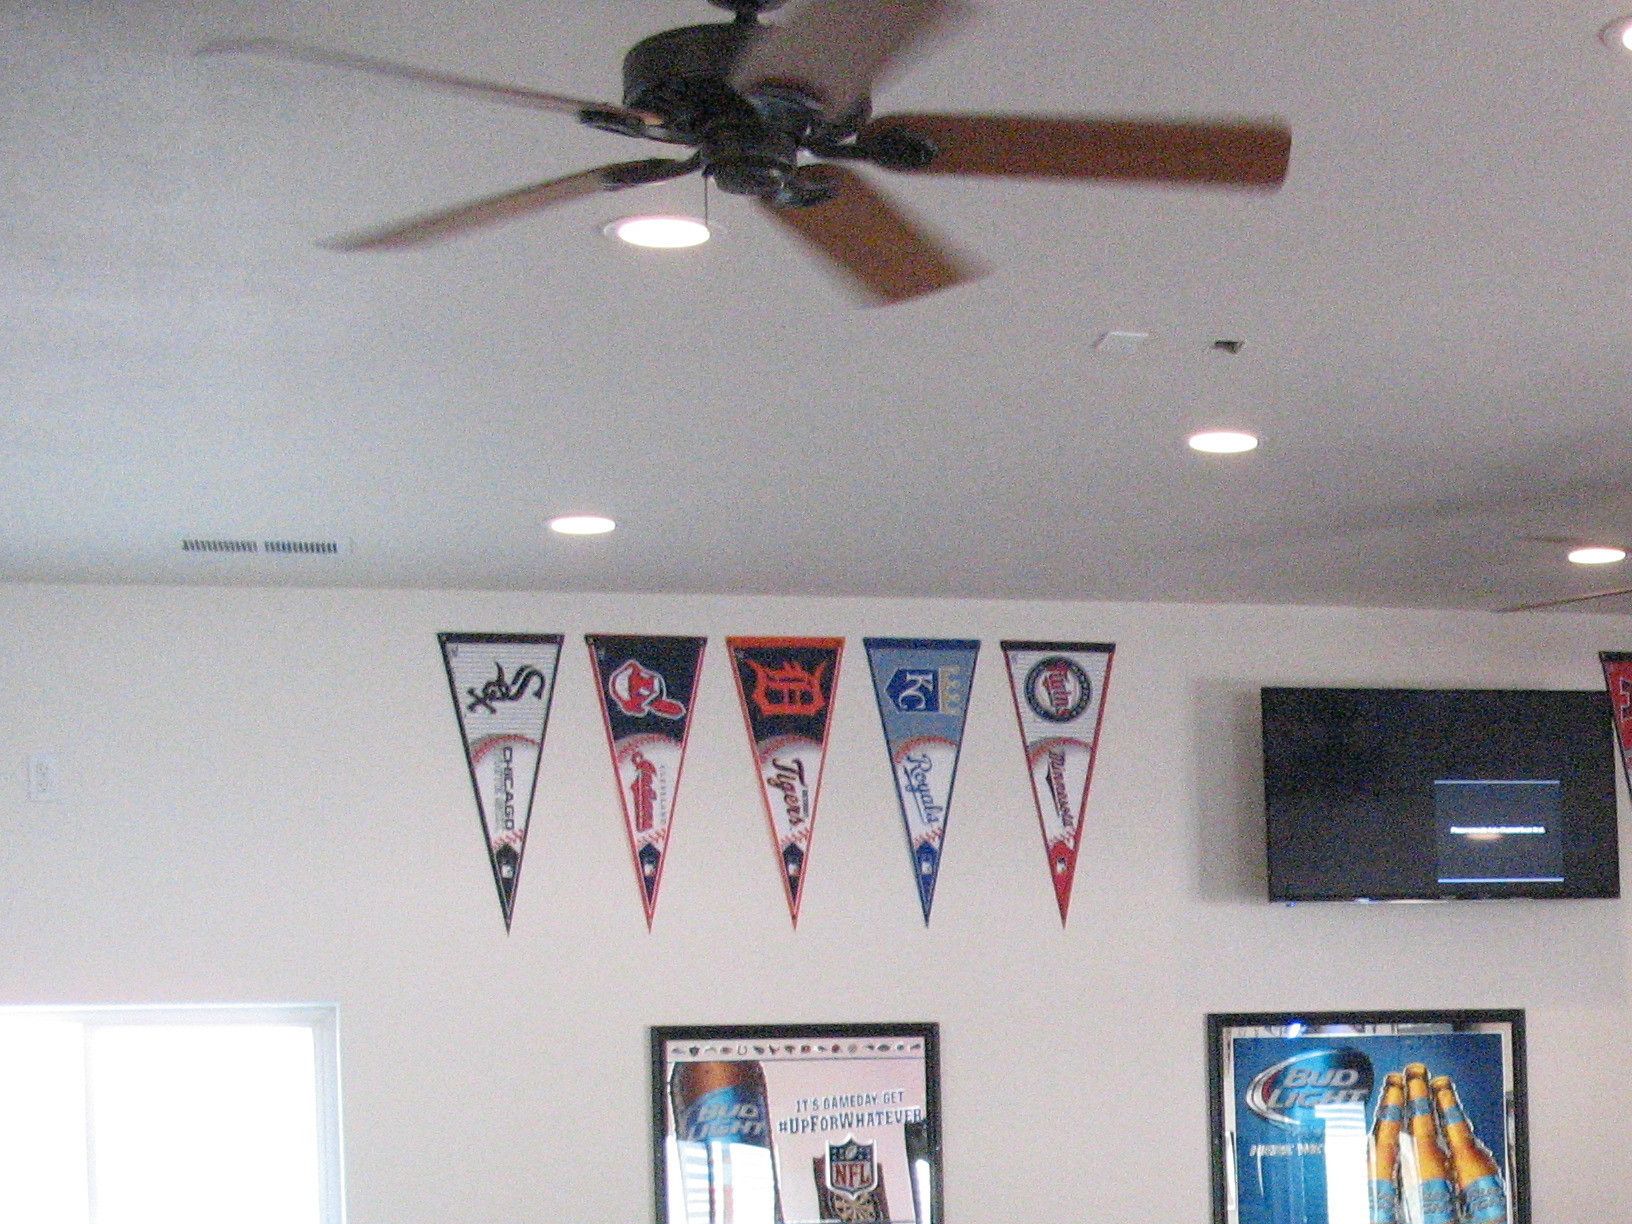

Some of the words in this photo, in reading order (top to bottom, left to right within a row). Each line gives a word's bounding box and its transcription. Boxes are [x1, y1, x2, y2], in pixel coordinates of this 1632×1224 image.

[1044, 661, 1074, 718] Twins
[503, 746, 514, 832] CHICAGO
[766, 758, 807, 828] Tigers
[904, 753, 944, 823] Royals
[1048, 751, 1074, 828] Minnesota
[1282, 1067, 1359, 1088] BUD
[698, 1103, 759, 1122] BUD
[796, 1098, 820, 1113] IT'S
[883, 1091, 905, 1103] GET
[1266, 1088, 1369, 1110] LIGHT
[834, 1162, 871, 1187] NFL
